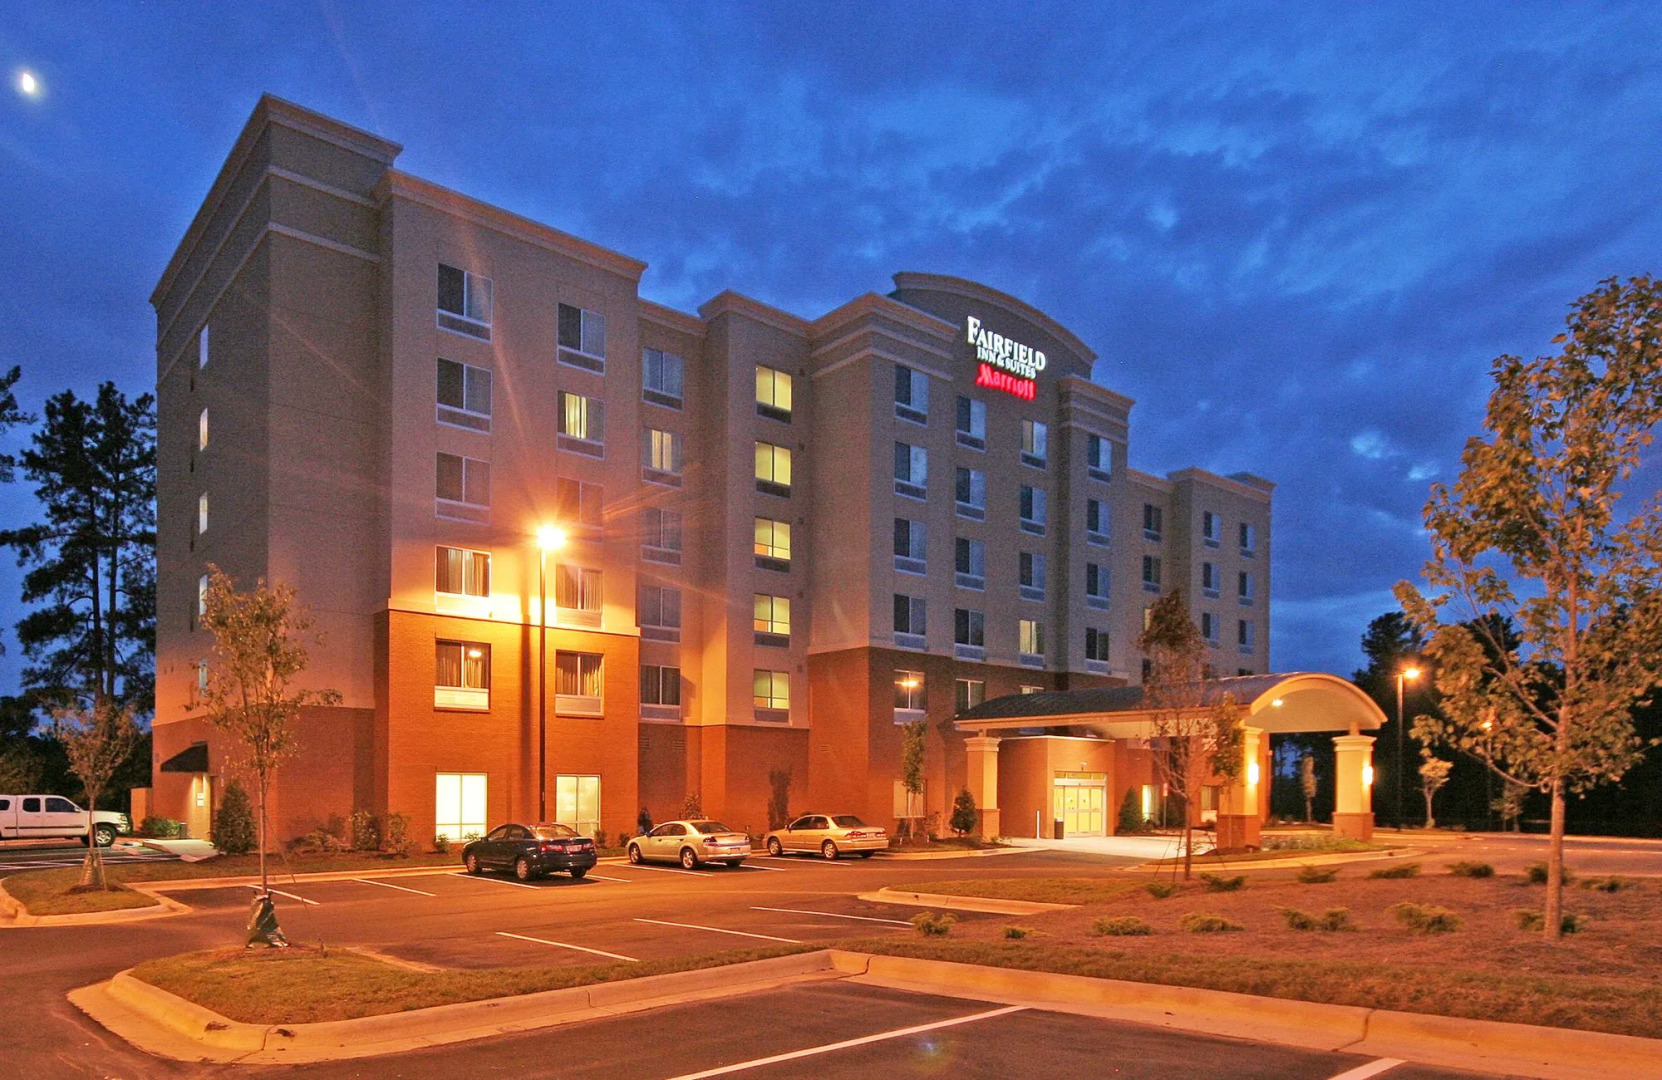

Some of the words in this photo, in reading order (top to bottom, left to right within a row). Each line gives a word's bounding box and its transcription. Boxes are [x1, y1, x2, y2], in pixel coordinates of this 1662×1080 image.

[967, 315, 1046, 371] FAIRFIELD
[977, 345, 996, 364] INN
[1005, 357, 1036, 379] SUITES
[976, 363, 1037, 401] Marriott
